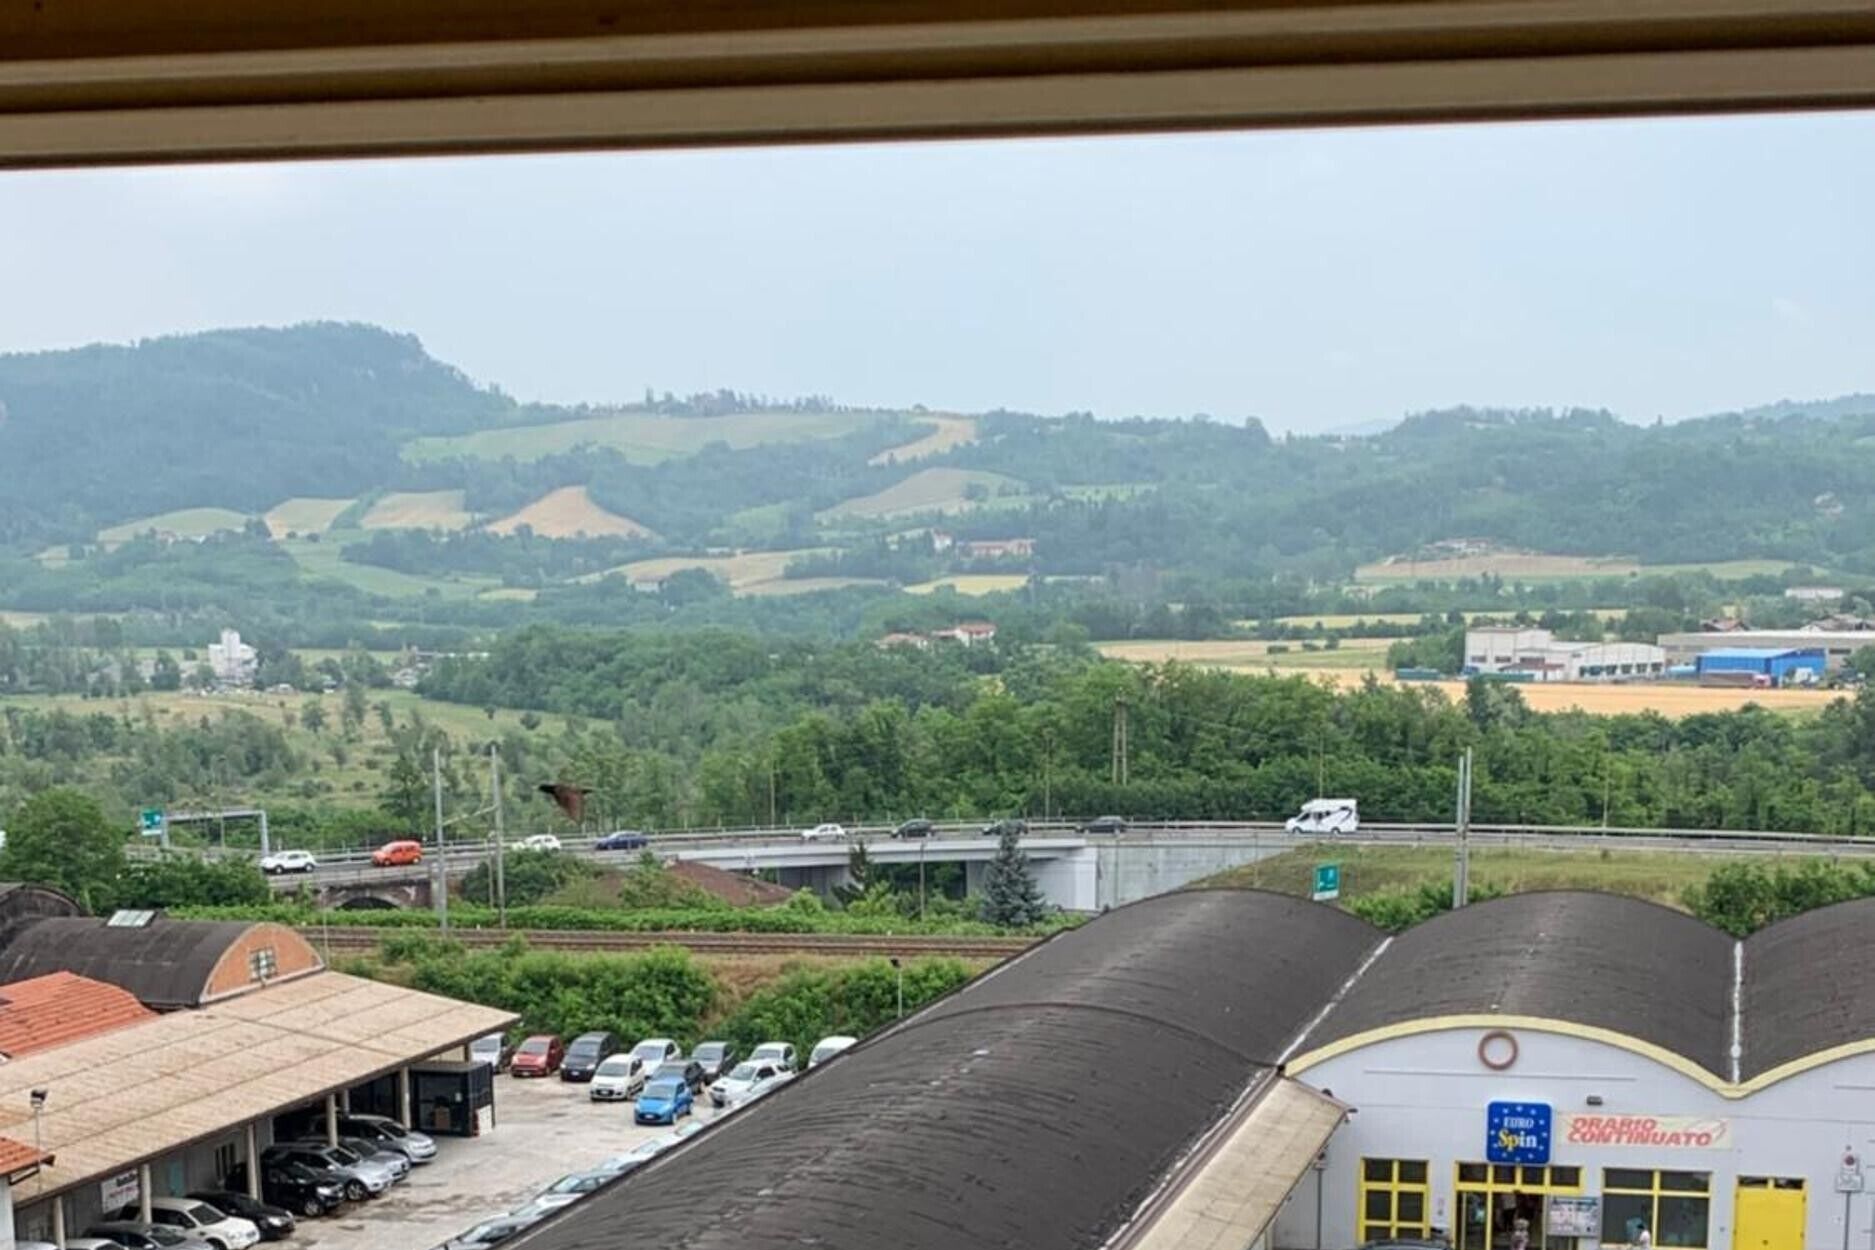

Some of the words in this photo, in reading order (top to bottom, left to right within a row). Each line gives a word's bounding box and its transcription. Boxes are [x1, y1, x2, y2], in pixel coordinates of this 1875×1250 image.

[1503, 1117, 1534, 1129] EURO
[1571, 1117, 1658, 1131] ORARIO
[1498, 1130, 1538, 1151] Spin
[1567, 1129, 1713, 1147] CONTINUATO
